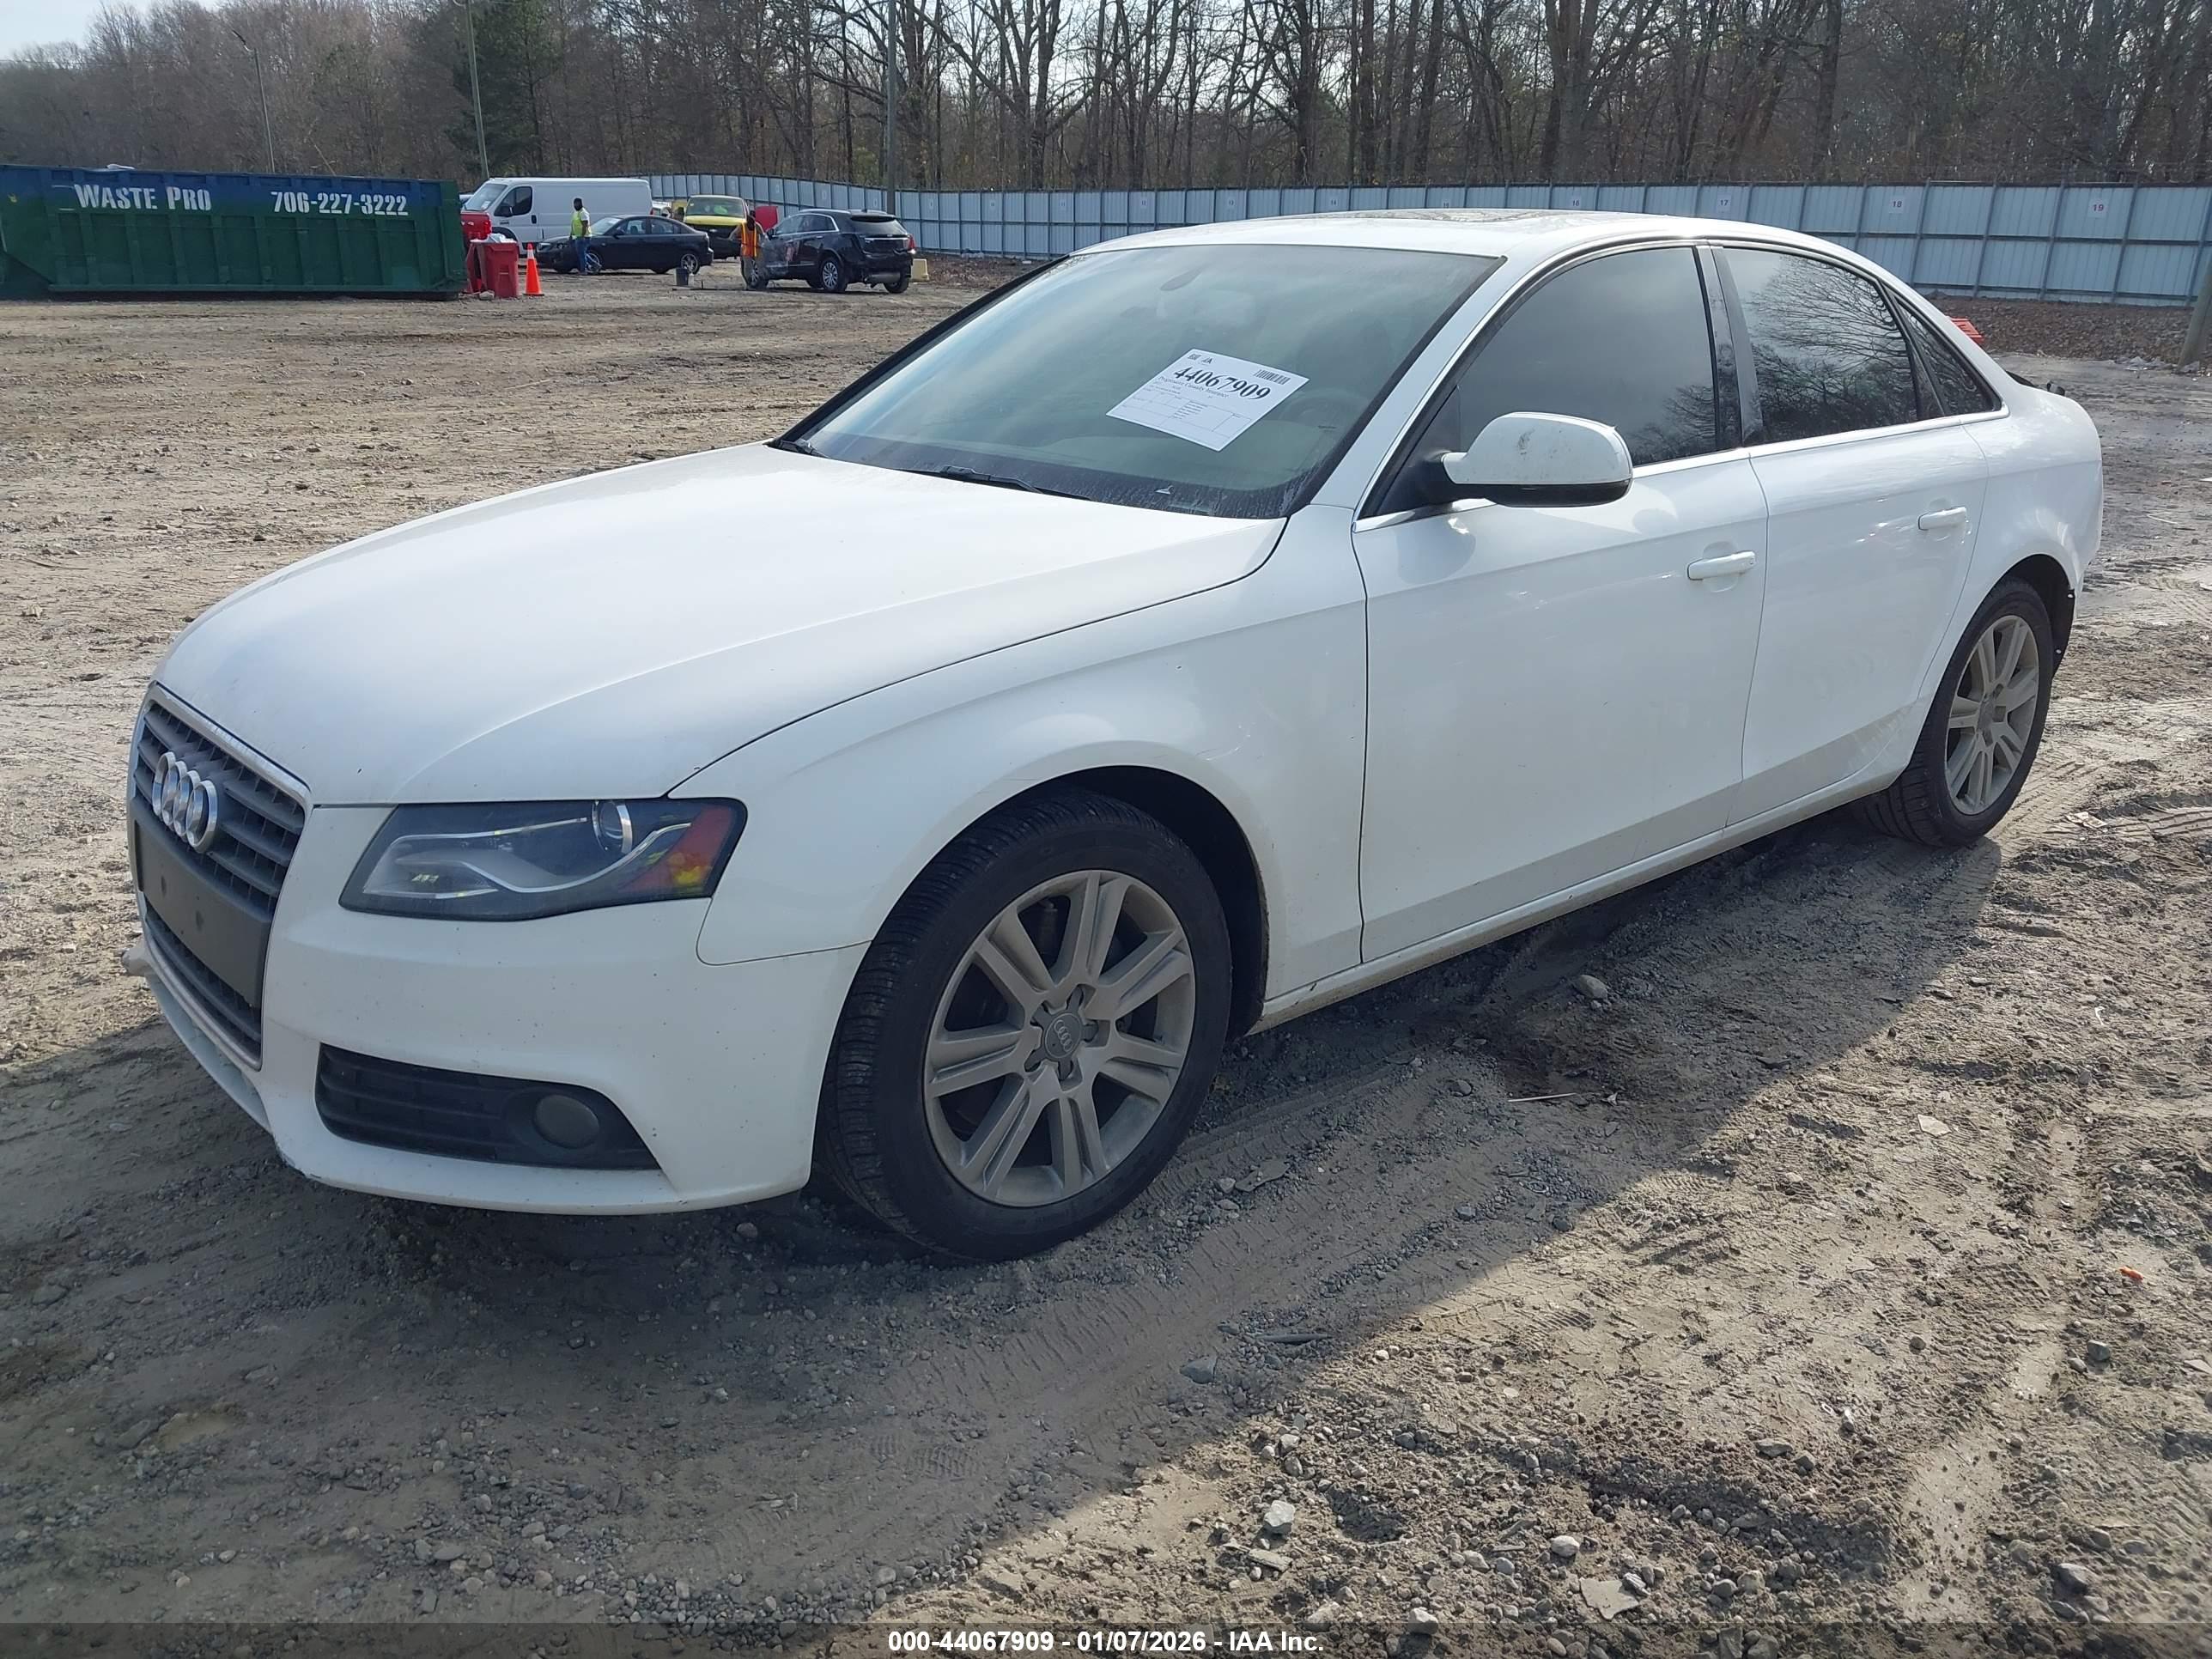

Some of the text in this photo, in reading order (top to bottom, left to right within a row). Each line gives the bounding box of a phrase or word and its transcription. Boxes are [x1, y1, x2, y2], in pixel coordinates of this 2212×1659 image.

[74, 184, 158, 210] WASTE
[270, 190, 409, 216] 706-227-3222
[1174, 366, 1271, 400] 44067909
